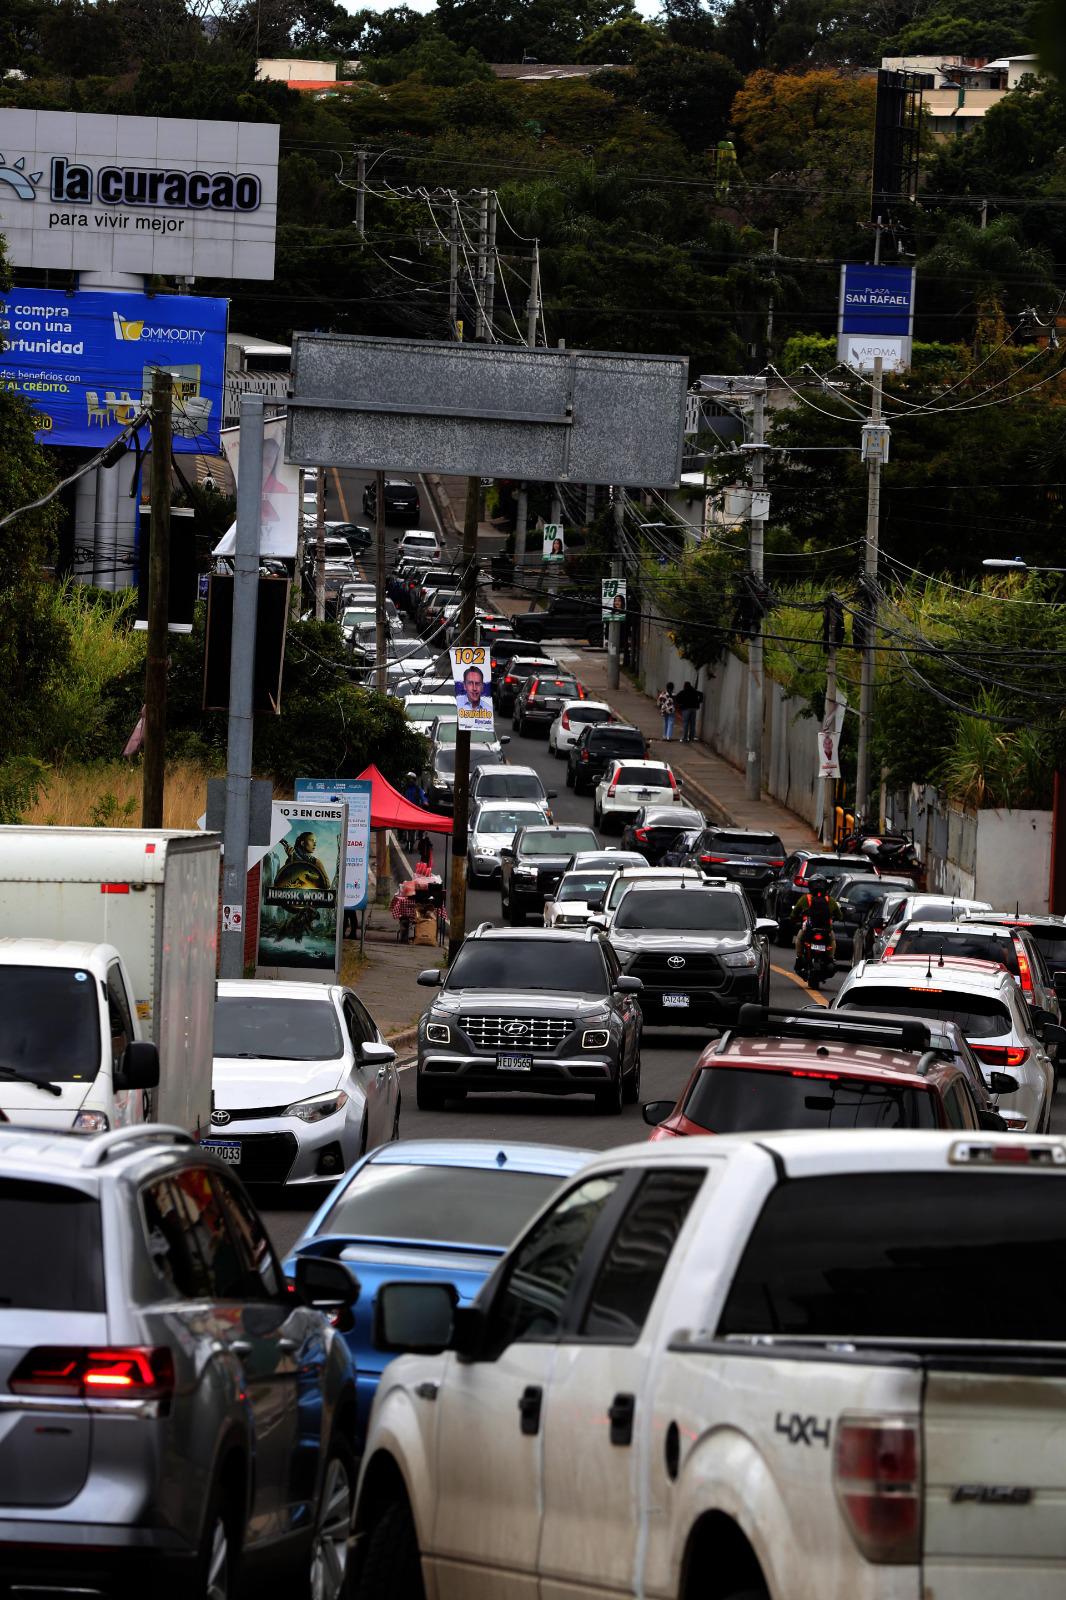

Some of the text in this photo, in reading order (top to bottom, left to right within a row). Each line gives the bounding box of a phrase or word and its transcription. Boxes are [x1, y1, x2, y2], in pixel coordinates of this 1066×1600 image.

[51, 158, 260, 211] la curacao
[49, 213, 184, 234] para vivir mejor
[846, 294, 909, 305] SAN RAFAEL
[15, 305, 69, 319] compra
[15, 321, 41, 332] con
[45, 322, 72, 333] una
[860, 347, 897, 357] AROMA
[18, 370, 63, 382] beneficios
[65, 374, 81, 382] con
[23, 381, 70, 393] CRÉDITO.
[544, 525, 557, 541] 10
[455, 647, 486, 665] 102
[315, 810, 342, 819] CINES
[267, 888, 300, 900] JURASSIC
[303, 891, 334, 902] WORLD
